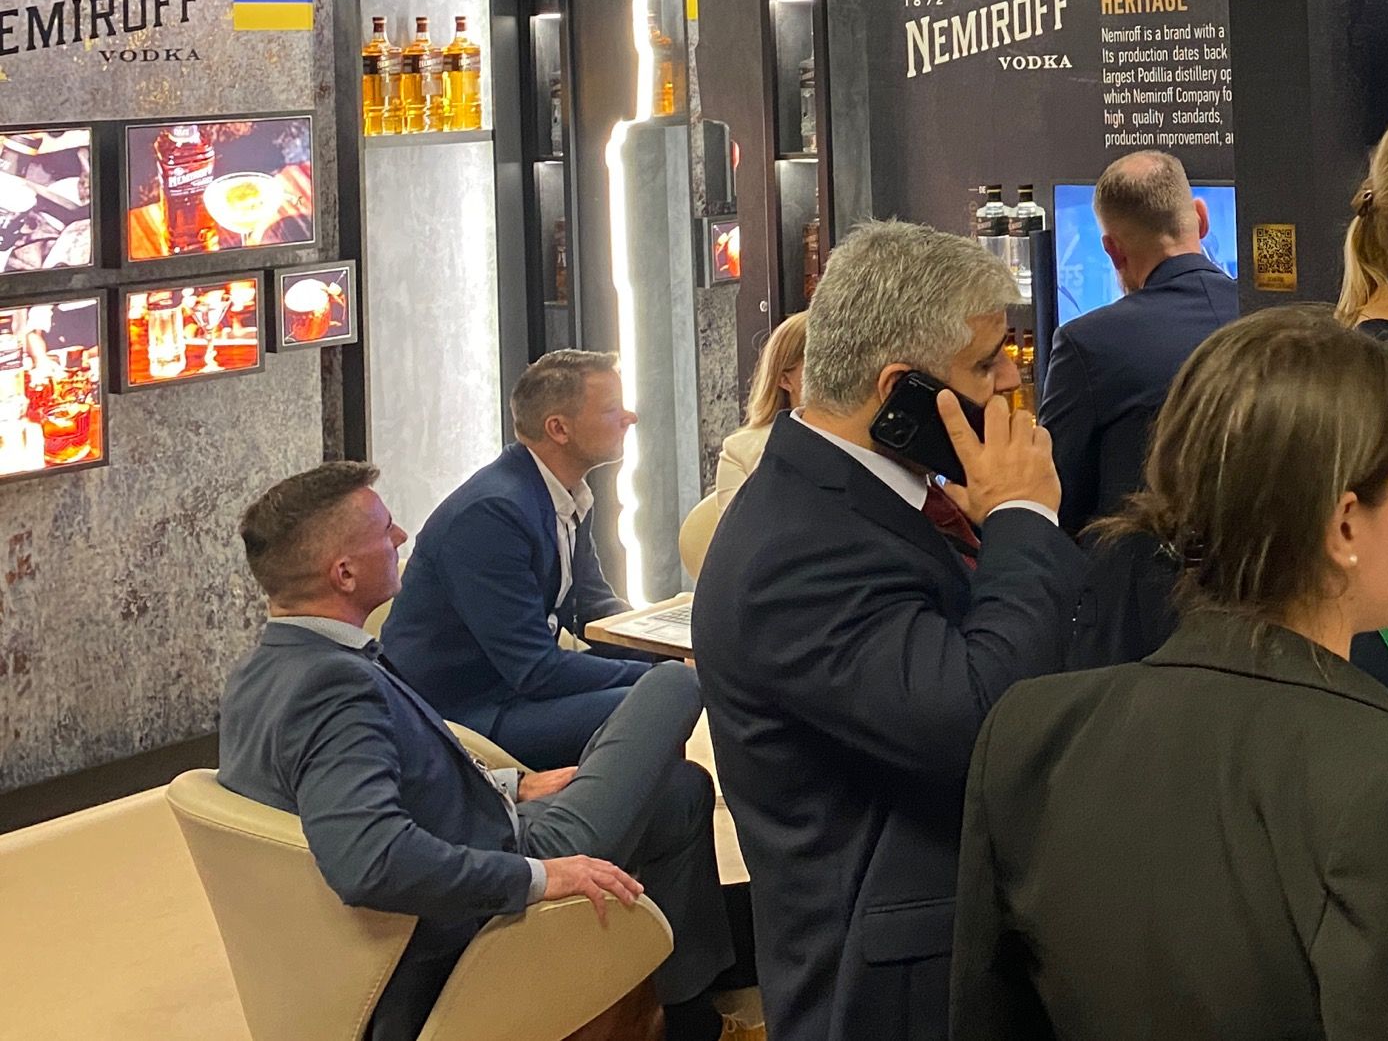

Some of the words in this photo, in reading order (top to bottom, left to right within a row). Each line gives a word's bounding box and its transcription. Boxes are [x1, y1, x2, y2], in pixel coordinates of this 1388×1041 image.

[1101, 25, 1141, 42] Nemiroff
[1144, 26, 1152, 41] is
[1156, 29, 1161, 41] a
[1164, 24, 1191, 40] brand
[1194, 23, 1215, 39] with
[1218, 26, 1224, 38] a
[99, 48, 201, 63] VODKA
[998, 54, 1072, 70] VODKA
[1102, 48, 1114, 63] Its
[1119, 47, 1168, 66] production
[1173, 45, 1199, 60] dates
[1204, 43, 1227, 59] back
[1103, 68, 1135, 87] largest
[1138, 67, 1172, 82] Podillia
[1176, 65, 1217, 85] distillery
[1104, 88, 1131, 104] which
[1133, 86, 1173, 104] Nemiroff
[1176, 87, 1220, 106] Company
[1104, 109, 1124, 128] high
[1132, 108, 1164, 128] quality
[1173, 107, 1222, 125] standards,
[1105, 129, 1154, 148] production
[1157, 129, 1222, 148] improvement,
